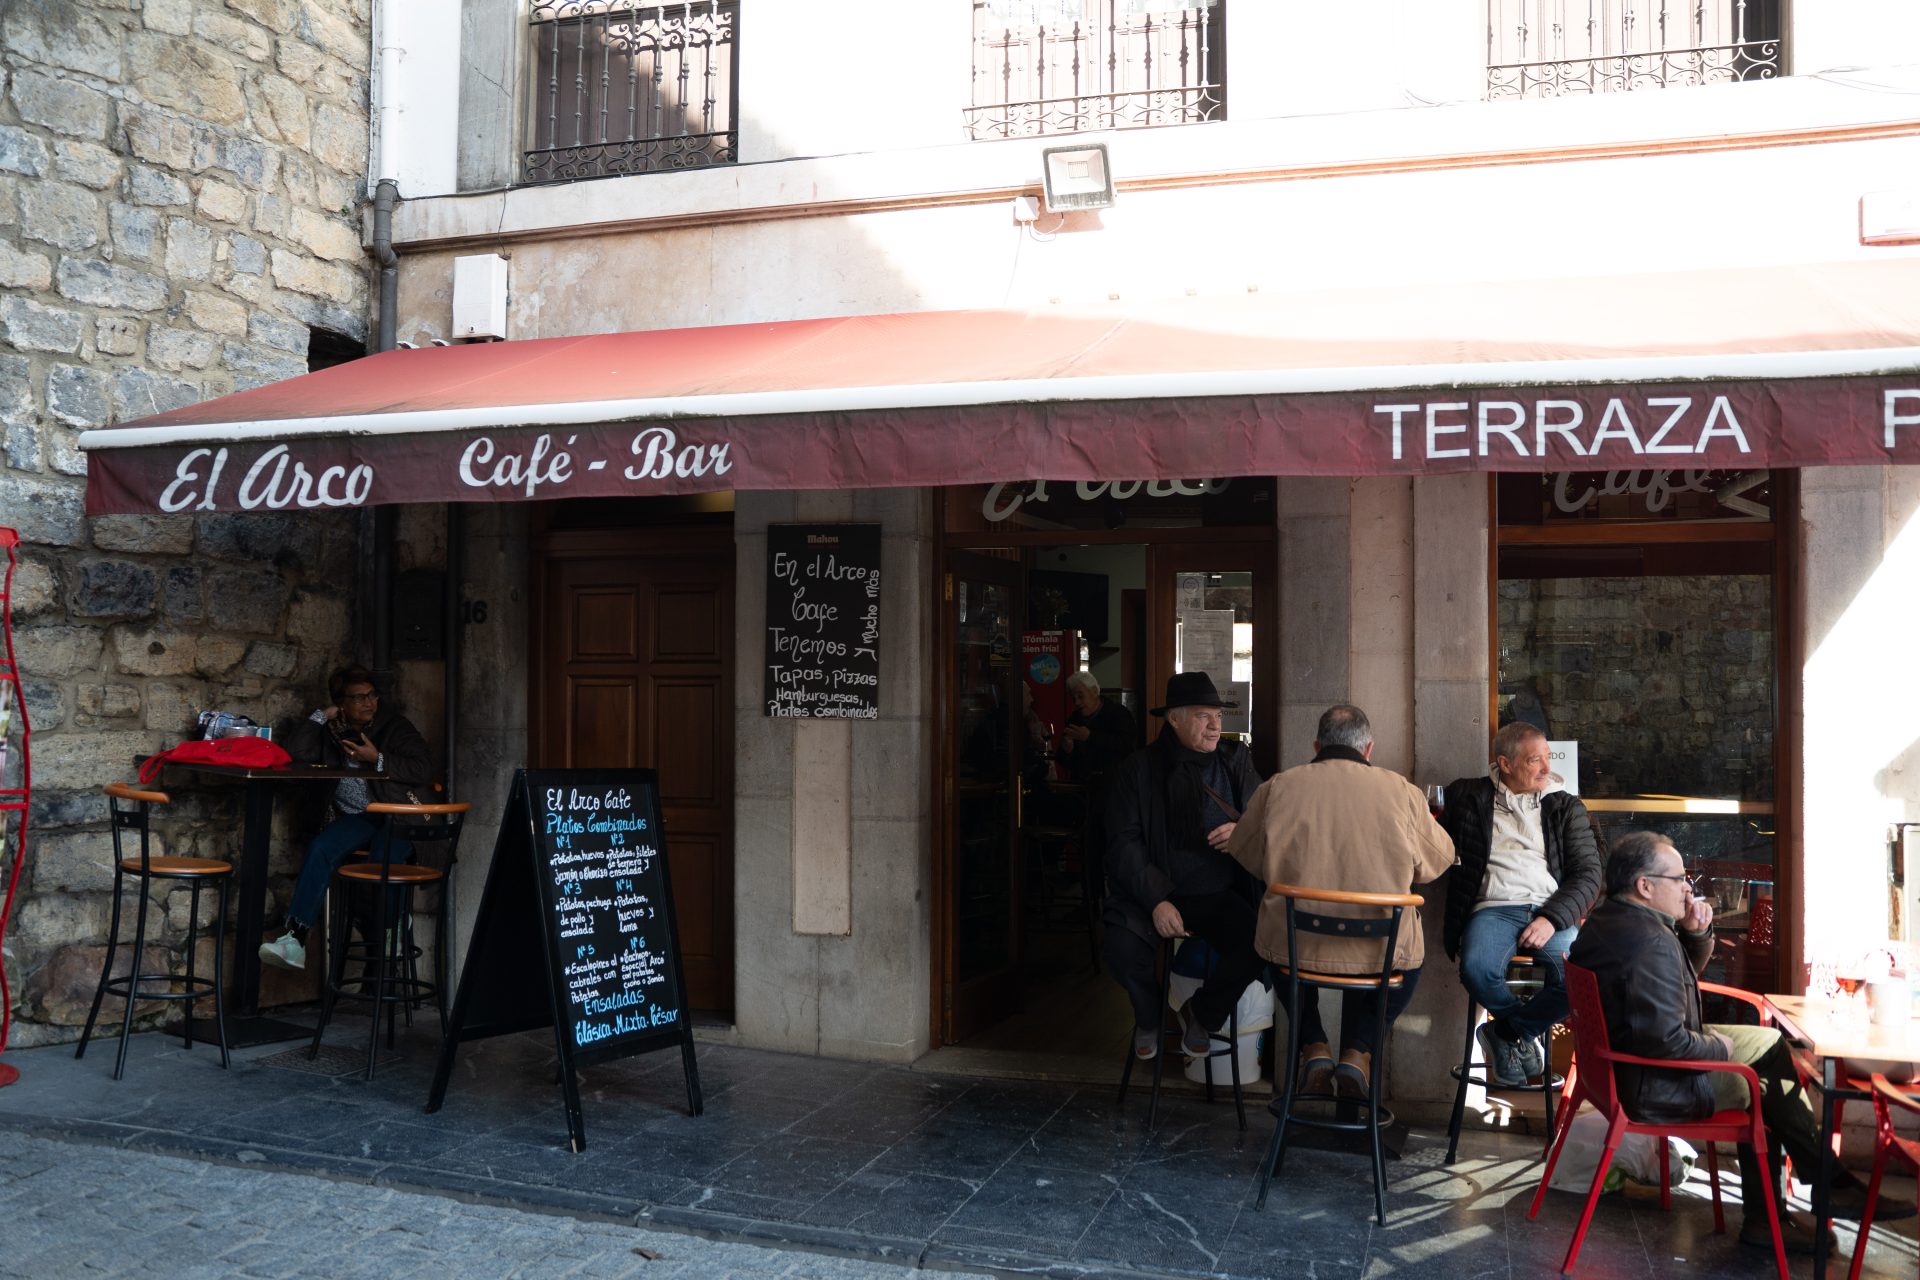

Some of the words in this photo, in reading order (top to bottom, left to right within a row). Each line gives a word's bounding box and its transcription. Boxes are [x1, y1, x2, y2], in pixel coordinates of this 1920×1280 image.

[1374, 395, 1751, 459] TERRAZA
[459, 433, 577, 497] Café
[624, 426, 733, 480] Bar
[159, 447, 229, 512] El
[239, 444, 374, 509] Arco
[807, 534, 840, 544] Mahou
[774, 551, 799, 587] En
[807, 554, 820, 579] el
[824, 554, 866, 581] Arco
[464, 600, 487, 624] 16
[768, 626, 847, 664] Tenemos
[768, 665, 830, 690] Tapas,
[767, 699, 810, 718] Platos
[813, 700, 878, 719] combinados
[546, 788, 563, 812] El
[568, 788, 600, 811] Arco
[546, 812, 585, 835] Platos
[587, 811, 647, 833] Combinados
[560, 912, 570, 927] de
[584, 988, 645, 1016] Ensaladas
